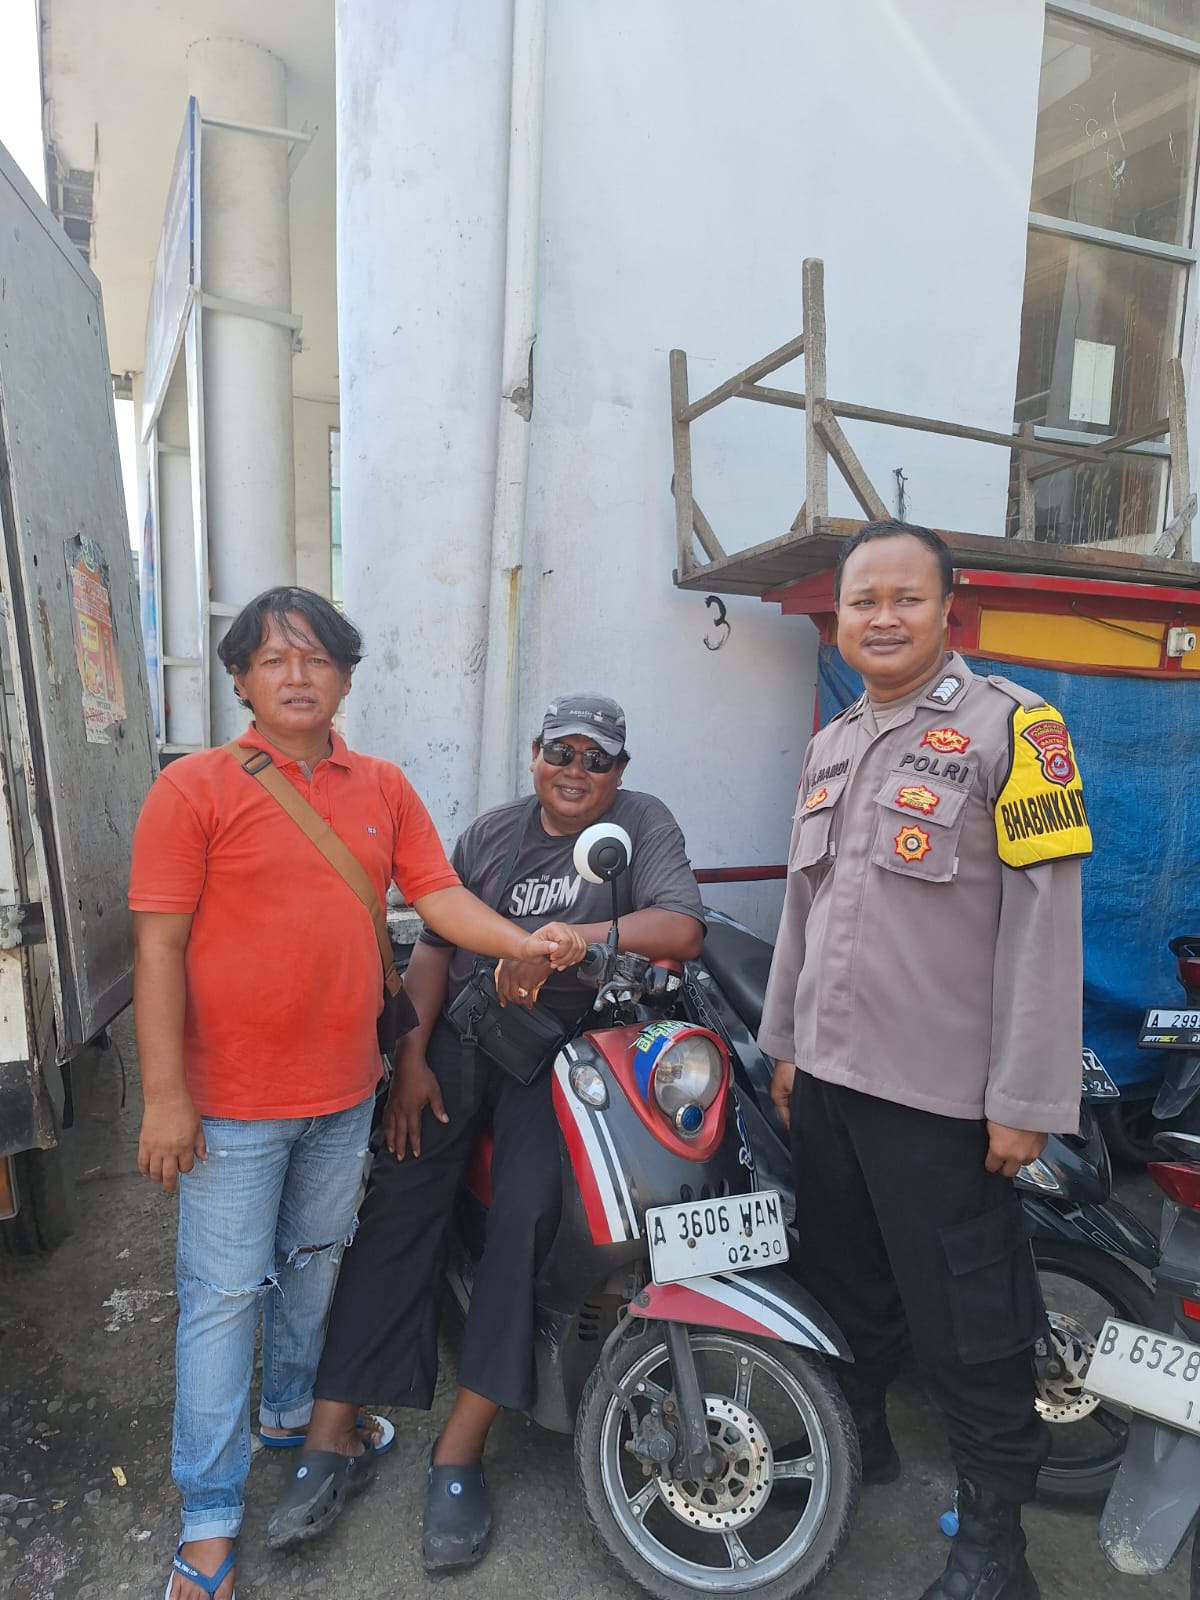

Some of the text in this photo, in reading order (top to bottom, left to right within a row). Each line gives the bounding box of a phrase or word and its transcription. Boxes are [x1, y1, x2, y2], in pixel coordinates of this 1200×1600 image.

[899, 752, 969, 783] POLRI
[508, 874, 582, 917] STORM
[1151, 1013, 1200, 1028] A 299
[653, 1198, 779, 1246] A 3606 WAN
[1100, 1325, 1200, 1382] B 6528
